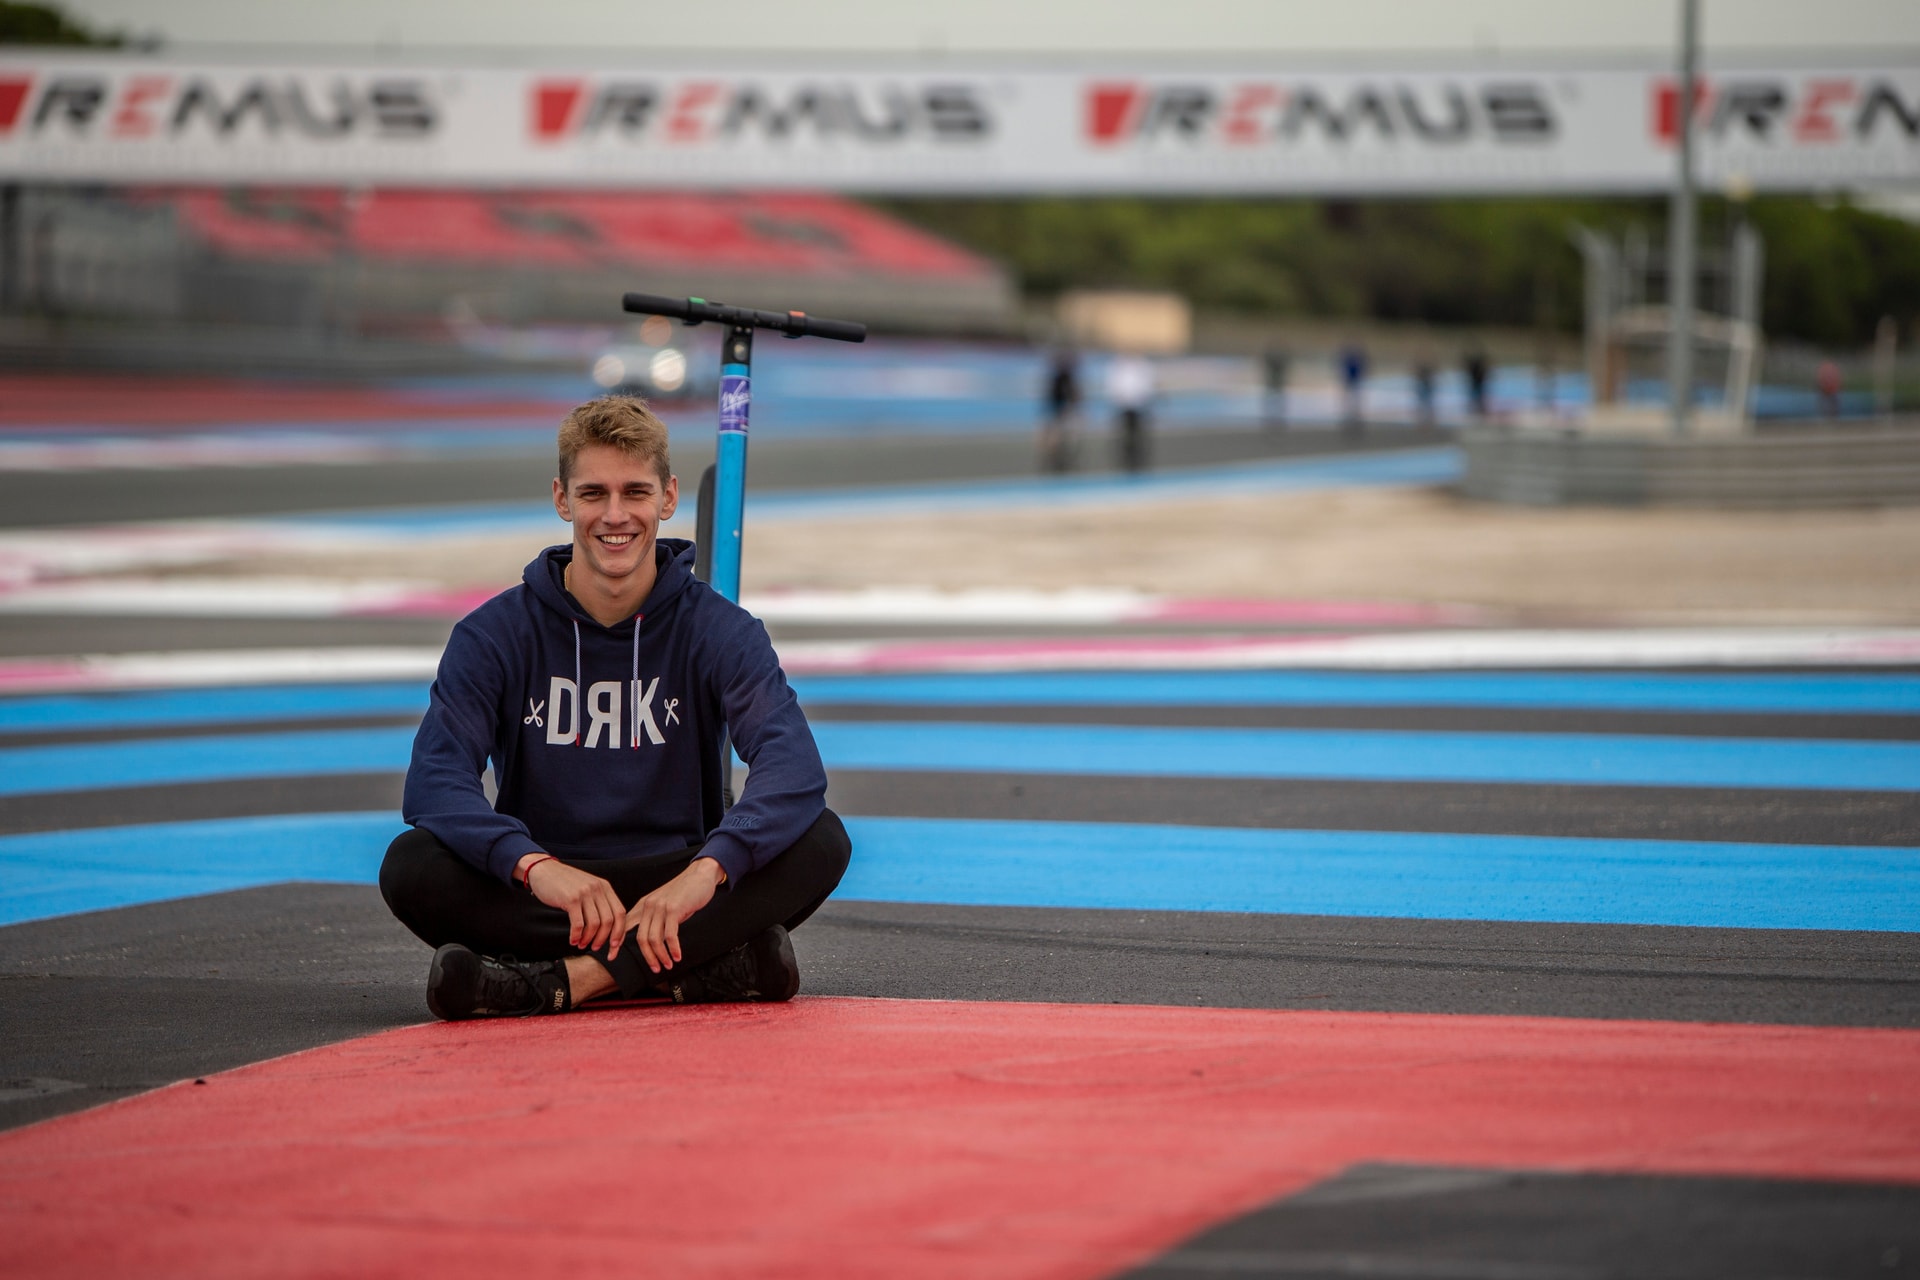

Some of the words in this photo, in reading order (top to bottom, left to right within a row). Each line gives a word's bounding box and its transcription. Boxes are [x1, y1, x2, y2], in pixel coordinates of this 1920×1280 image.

[24, 78, 442, 138] REMUS
[578, 81, 992, 145] REMUS
[1136, 82, 1560, 146] REMUS
